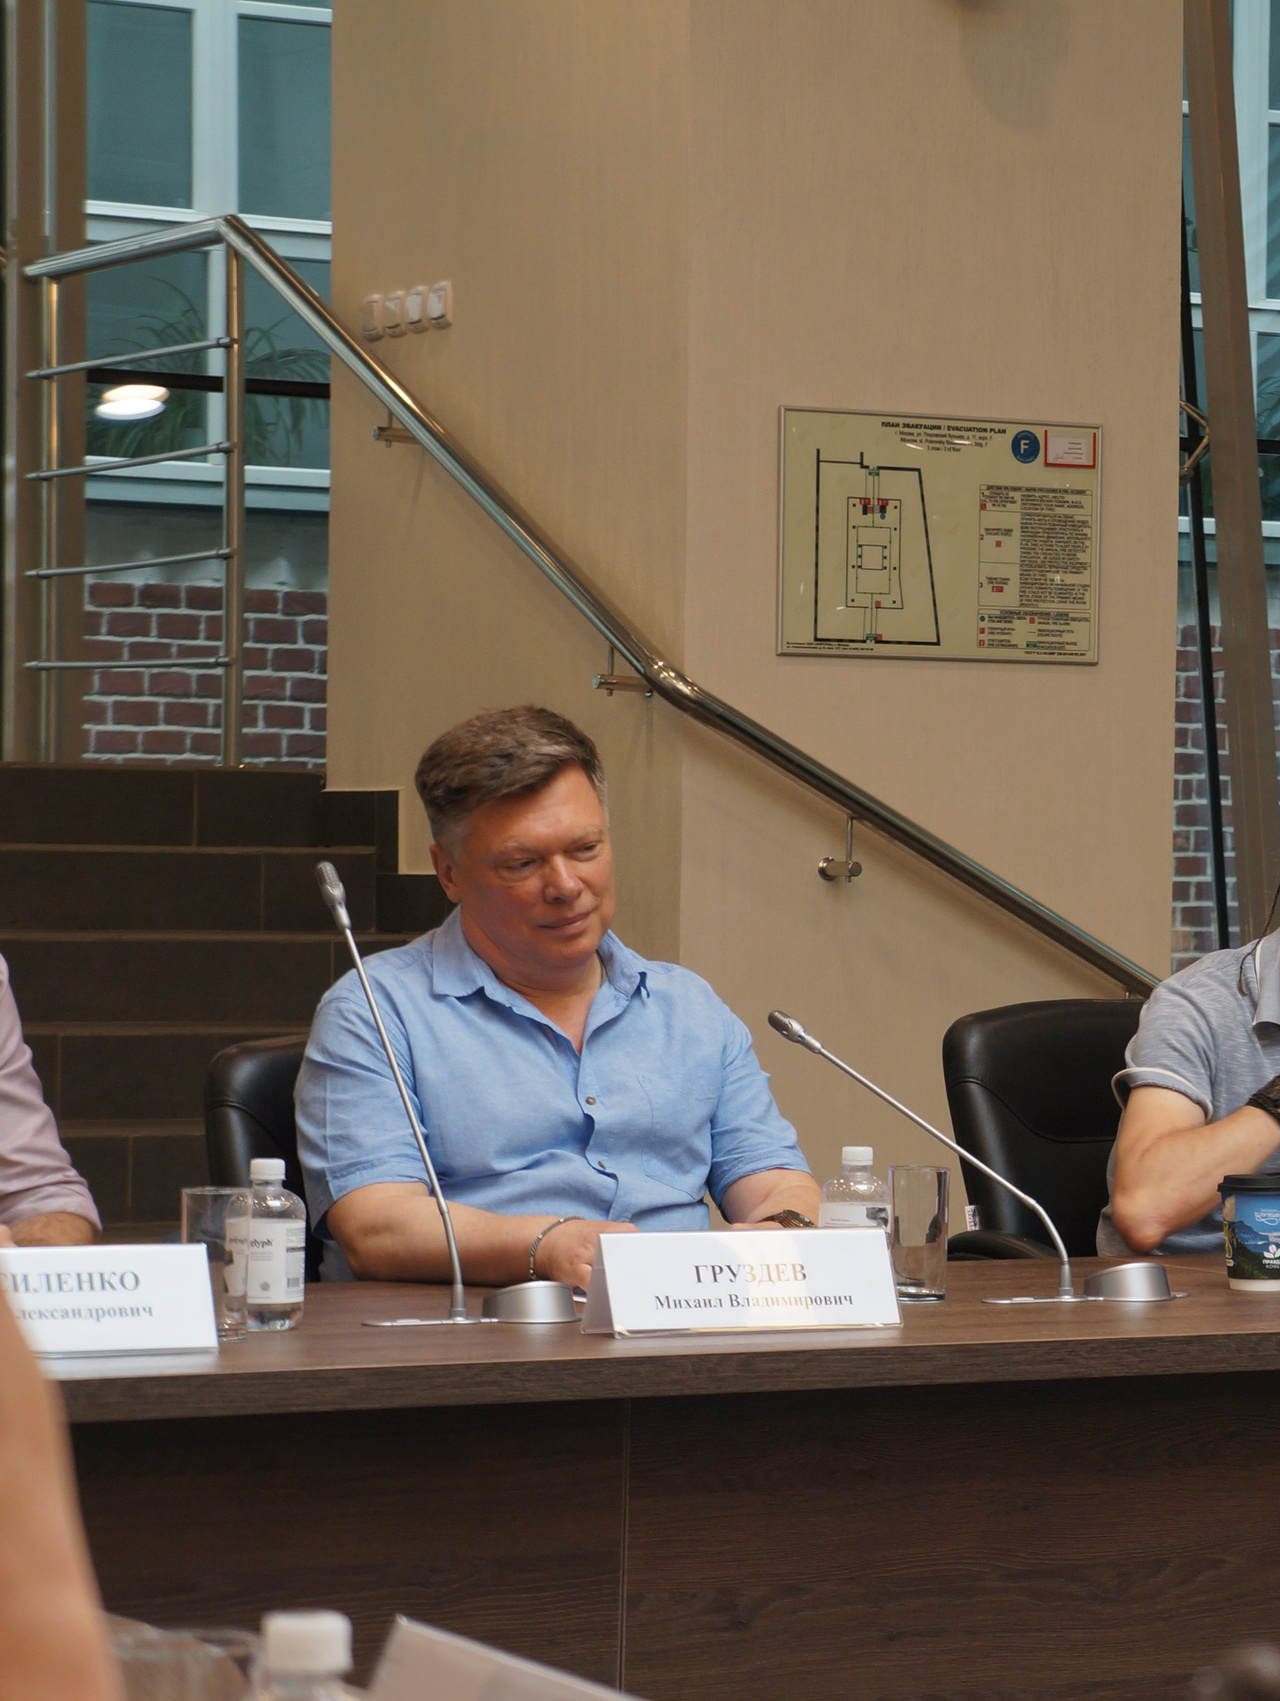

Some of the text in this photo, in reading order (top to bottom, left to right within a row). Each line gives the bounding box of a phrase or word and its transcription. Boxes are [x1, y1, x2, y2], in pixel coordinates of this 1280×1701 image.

[902, 423, 942, 431] ЭВАКУАЦИИ
[946, 425, 988, 433] EVACUATION
[1020, 440, 1029, 454] F
[694, 1262, 808, 1285] ГРУЗДЕВ
[654, 1292, 855, 1311] Михаил Владимирович
